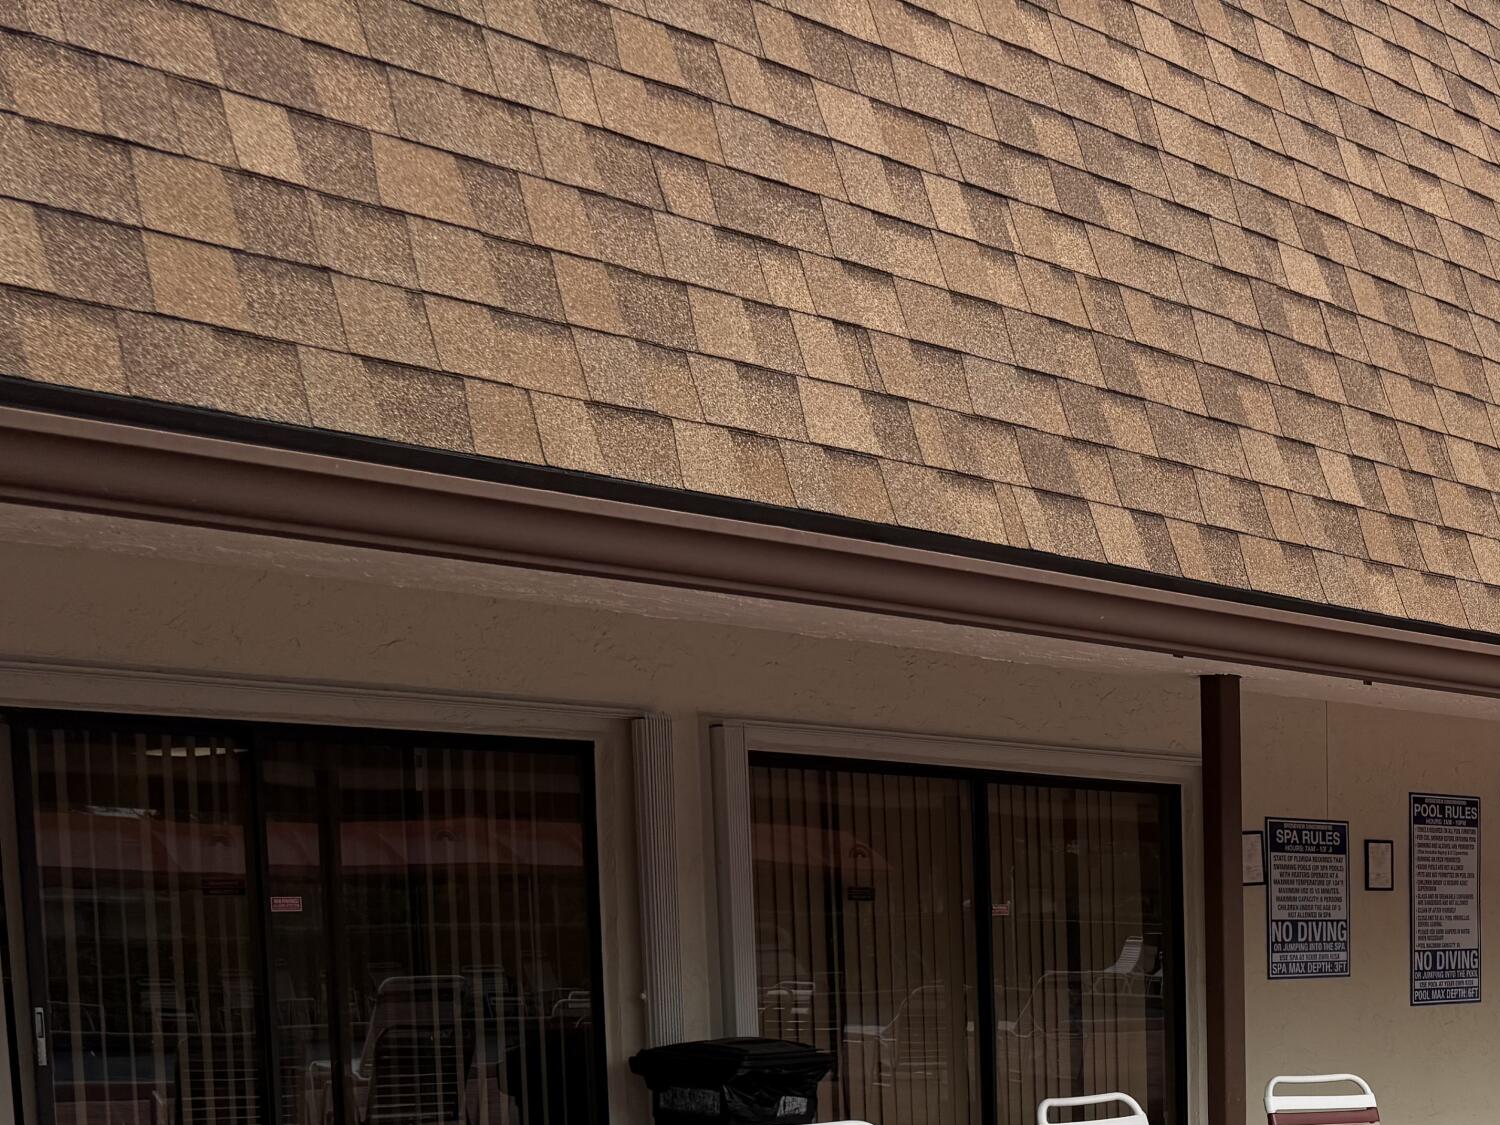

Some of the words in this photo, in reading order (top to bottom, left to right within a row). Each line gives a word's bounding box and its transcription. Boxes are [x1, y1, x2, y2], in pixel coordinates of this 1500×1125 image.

[1414, 804, 1443, 818] POOL
[1445, 805, 1478, 820] RULES
[1276, 829, 1299, 844] SPA
[1302, 830, 1341, 846] RULES
[1272, 921, 1293, 942] NO
[1297, 921, 1347, 942] DIVING
[1273, 943, 1282, 951] OR
[1283, 943, 1308, 951] JUMPING
[1309, 943, 1322, 951] INTO
[1322, 943, 1334, 951] THE
[1334, 942, 1346, 951] SPA
[1272, 962, 1287, 974] SPA
[1288, 962, 1306, 974] MAX
[1307, 961, 1333, 973] DEPTH:
[1334, 961, 1347, 973] 3FT
[1415, 951, 1432, 970] NO
[1436, 950, 1478, 970] DIVING
[1415, 989, 1430, 1000] POOL
[1431, 989, 1446, 1000] MAX
[1467, 987, 1478, 998] 6FT
